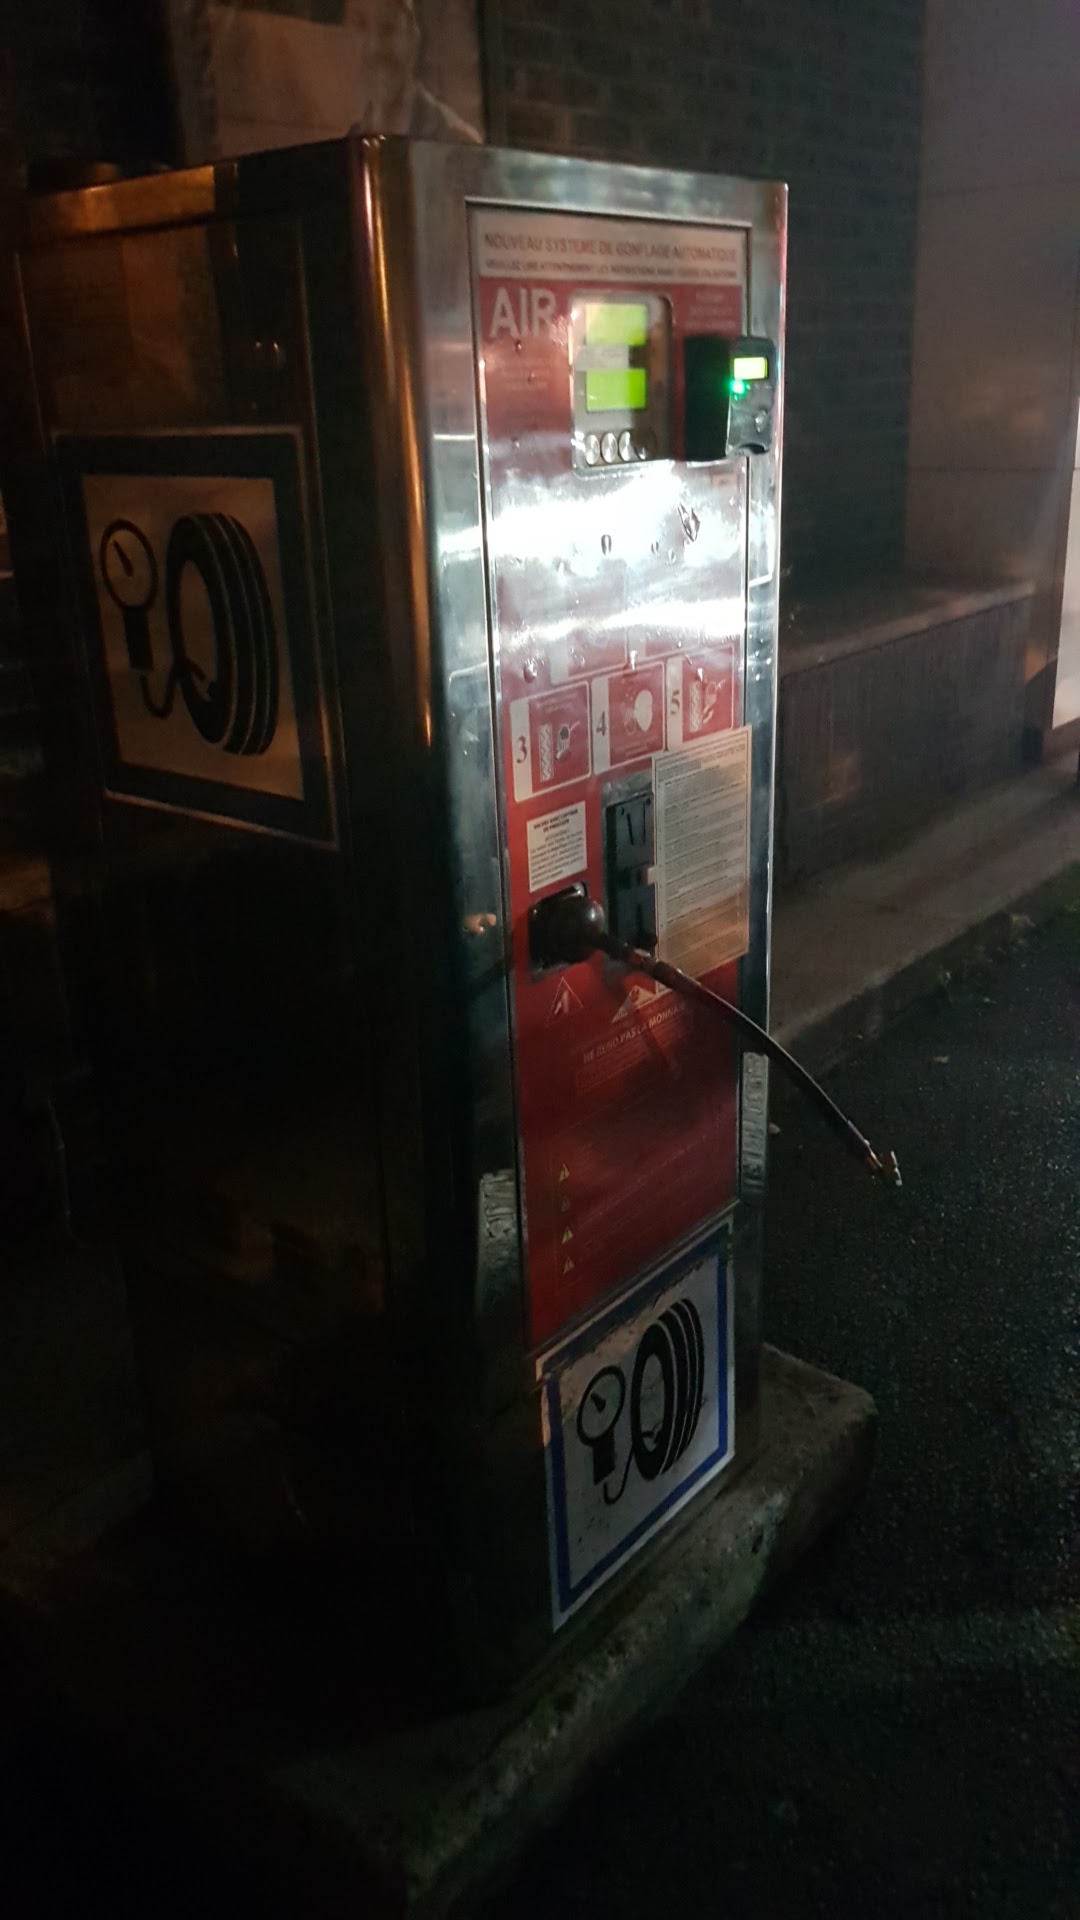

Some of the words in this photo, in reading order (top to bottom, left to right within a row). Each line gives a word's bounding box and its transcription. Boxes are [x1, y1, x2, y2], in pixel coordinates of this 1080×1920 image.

[485, 232, 542, 251] NOUVEAU
[489, 287, 556, 338] AIR
[670, 690, 681, 715] 5
[596, 711, 608, 737] 4
[516, 735, 528, 763] 3
[620, 1027, 637, 1043] PAS
